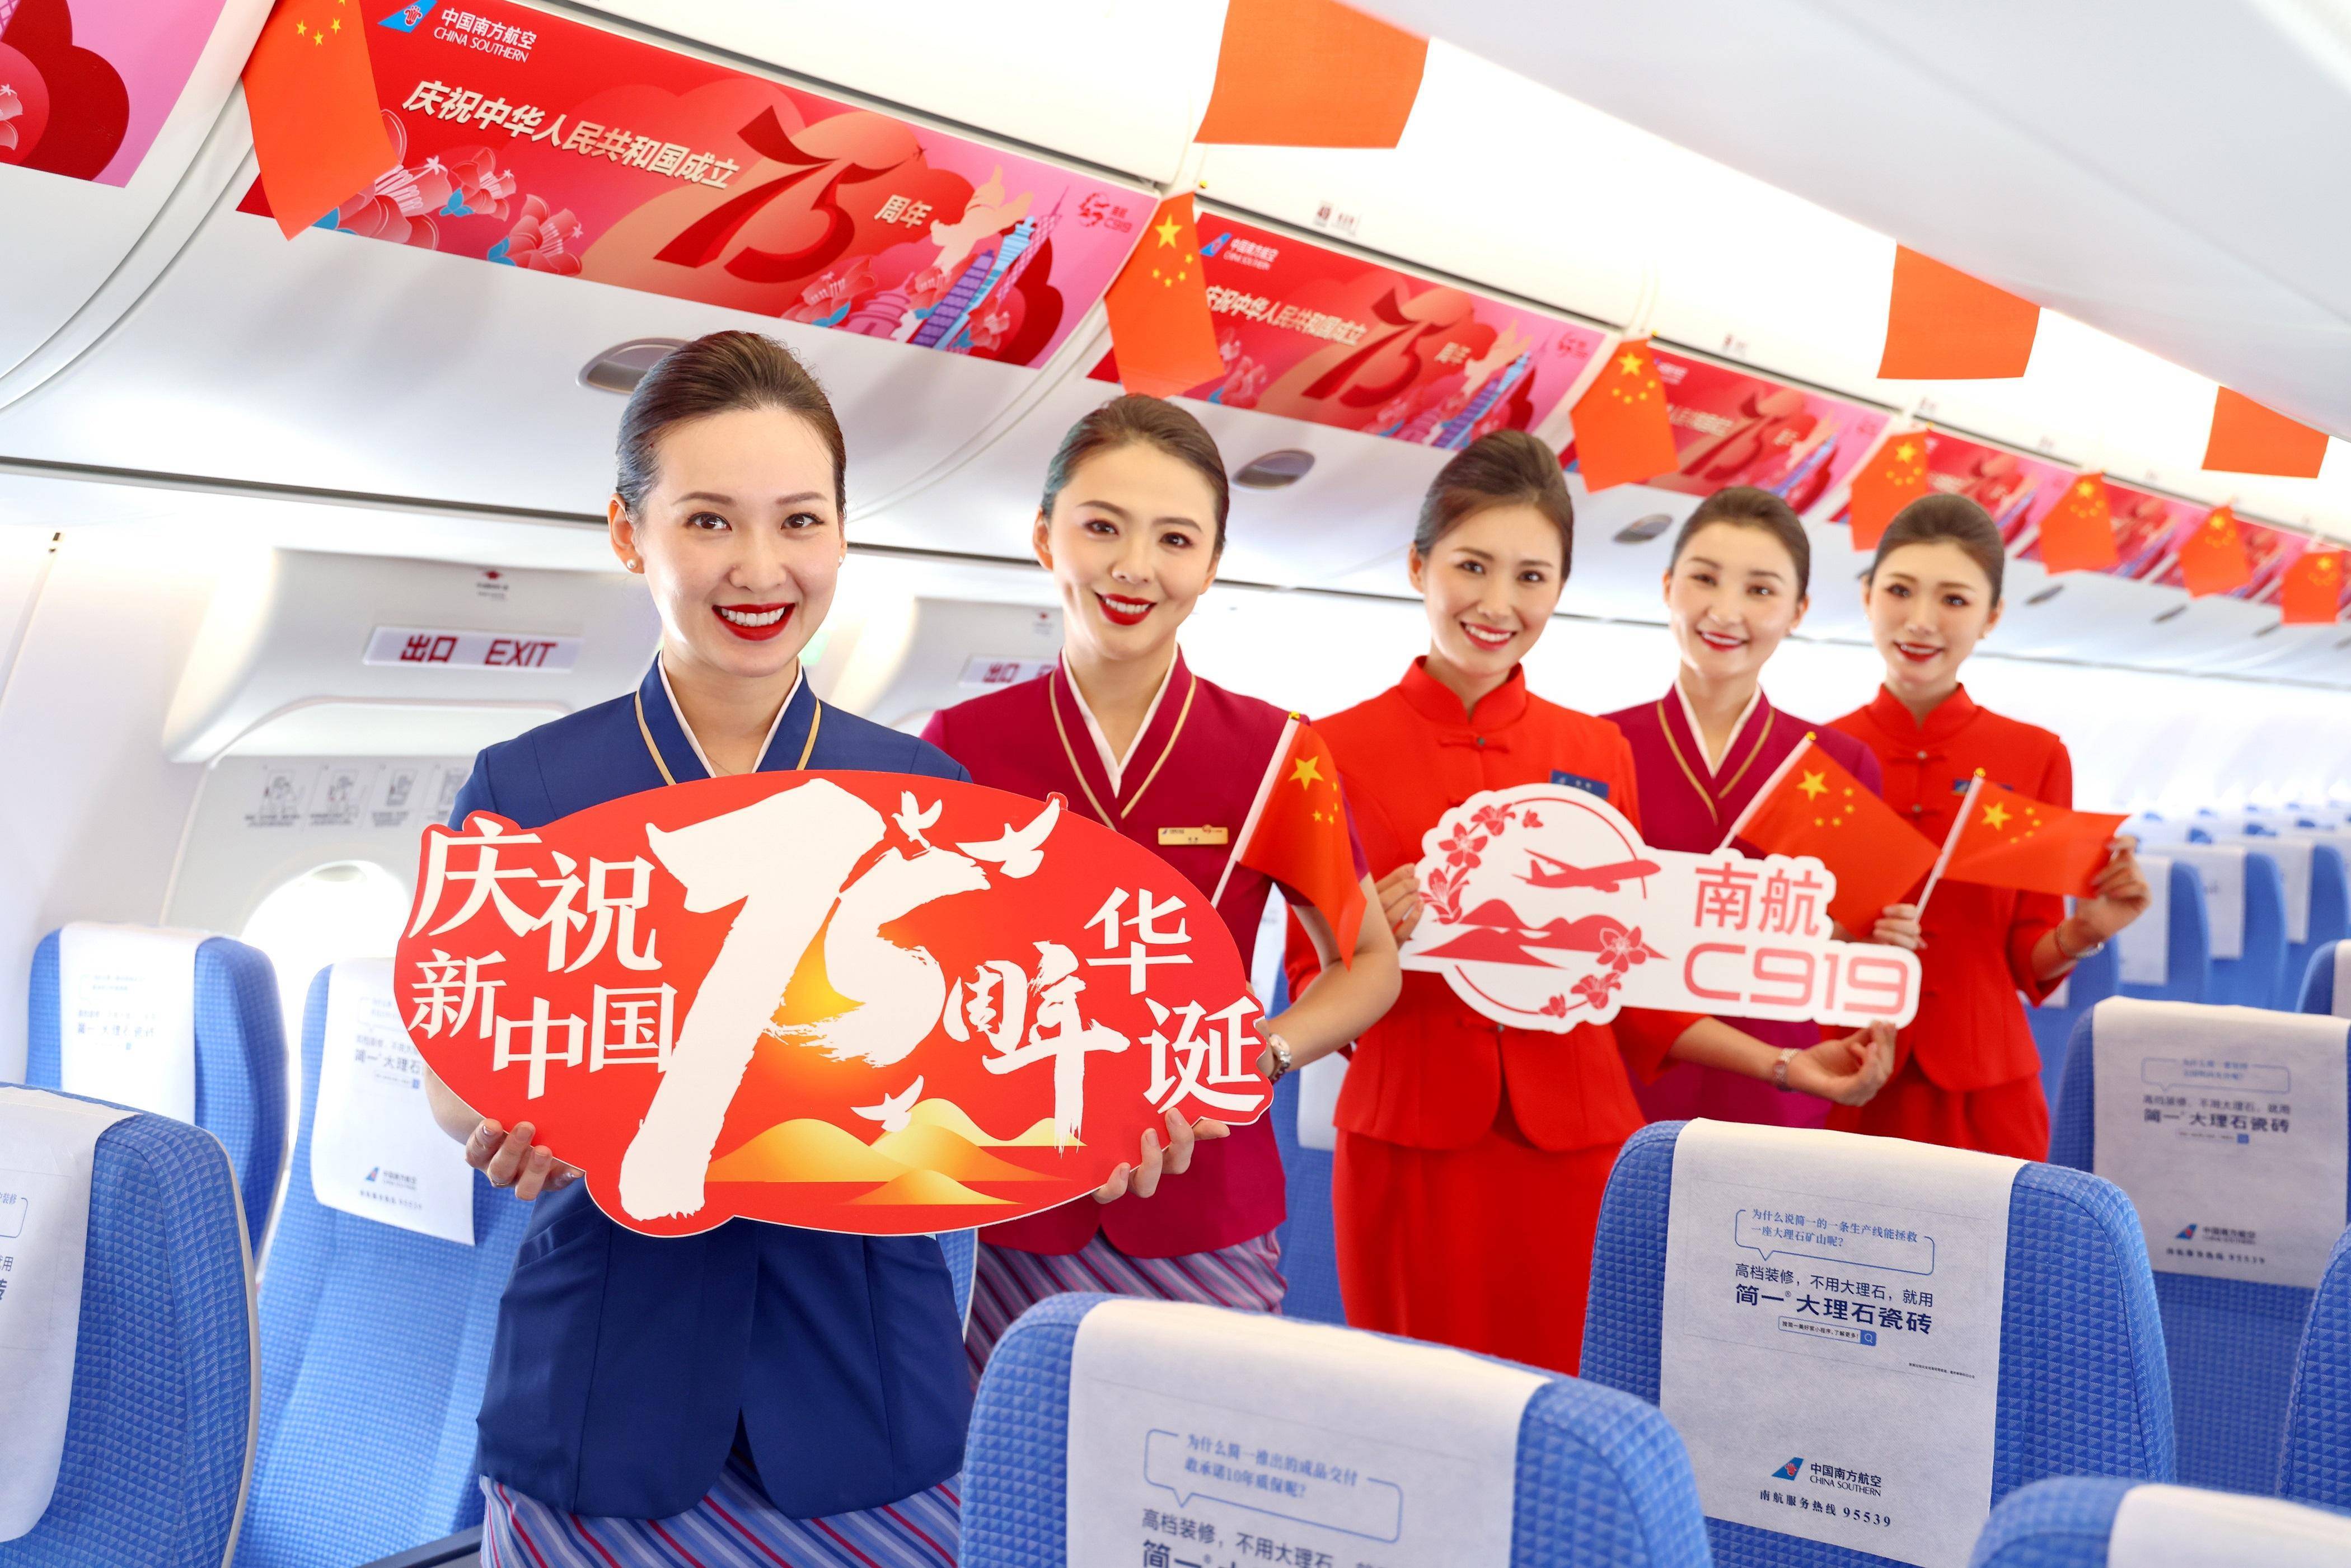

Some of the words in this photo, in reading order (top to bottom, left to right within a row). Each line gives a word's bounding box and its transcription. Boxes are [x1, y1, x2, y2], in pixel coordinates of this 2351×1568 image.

[434, 27, 468, 46] CHINA
[470, 37, 529, 63] SOUTHERN
[441, 8, 537, 50] 中国南方航空
[402, 81, 739, 189] 庆祝中华人民共和国成立
[874, 194, 933, 228] 周年
[400, 634, 459, 662] 出口
[484, 639, 559, 667] EXIT
[982, 661, 1020, 684] 出口
[408, 816, 663, 973] 庆祝
[1694, 862, 1823, 937] 南航
[1683, 942, 1909, 1015] C919
[407, 948, 678, 1101] 新中国
[1752, 1209, 1918, 1243] 为什么说简一的一条生产线能拯救
[1735, 1262, 1933, 1308] 高档装修，不用大理石，就用
[1810, 1462, 1882, 1489] 中国南方航空
[1810, 1475, 1835, 1487] CHINA
[1837, 1481, 1881, 1497] SOUTHERN
[1760, 1489, 1837, 1516] 南航服务热线
[1843, 1506, 1891, 1527] 95539
